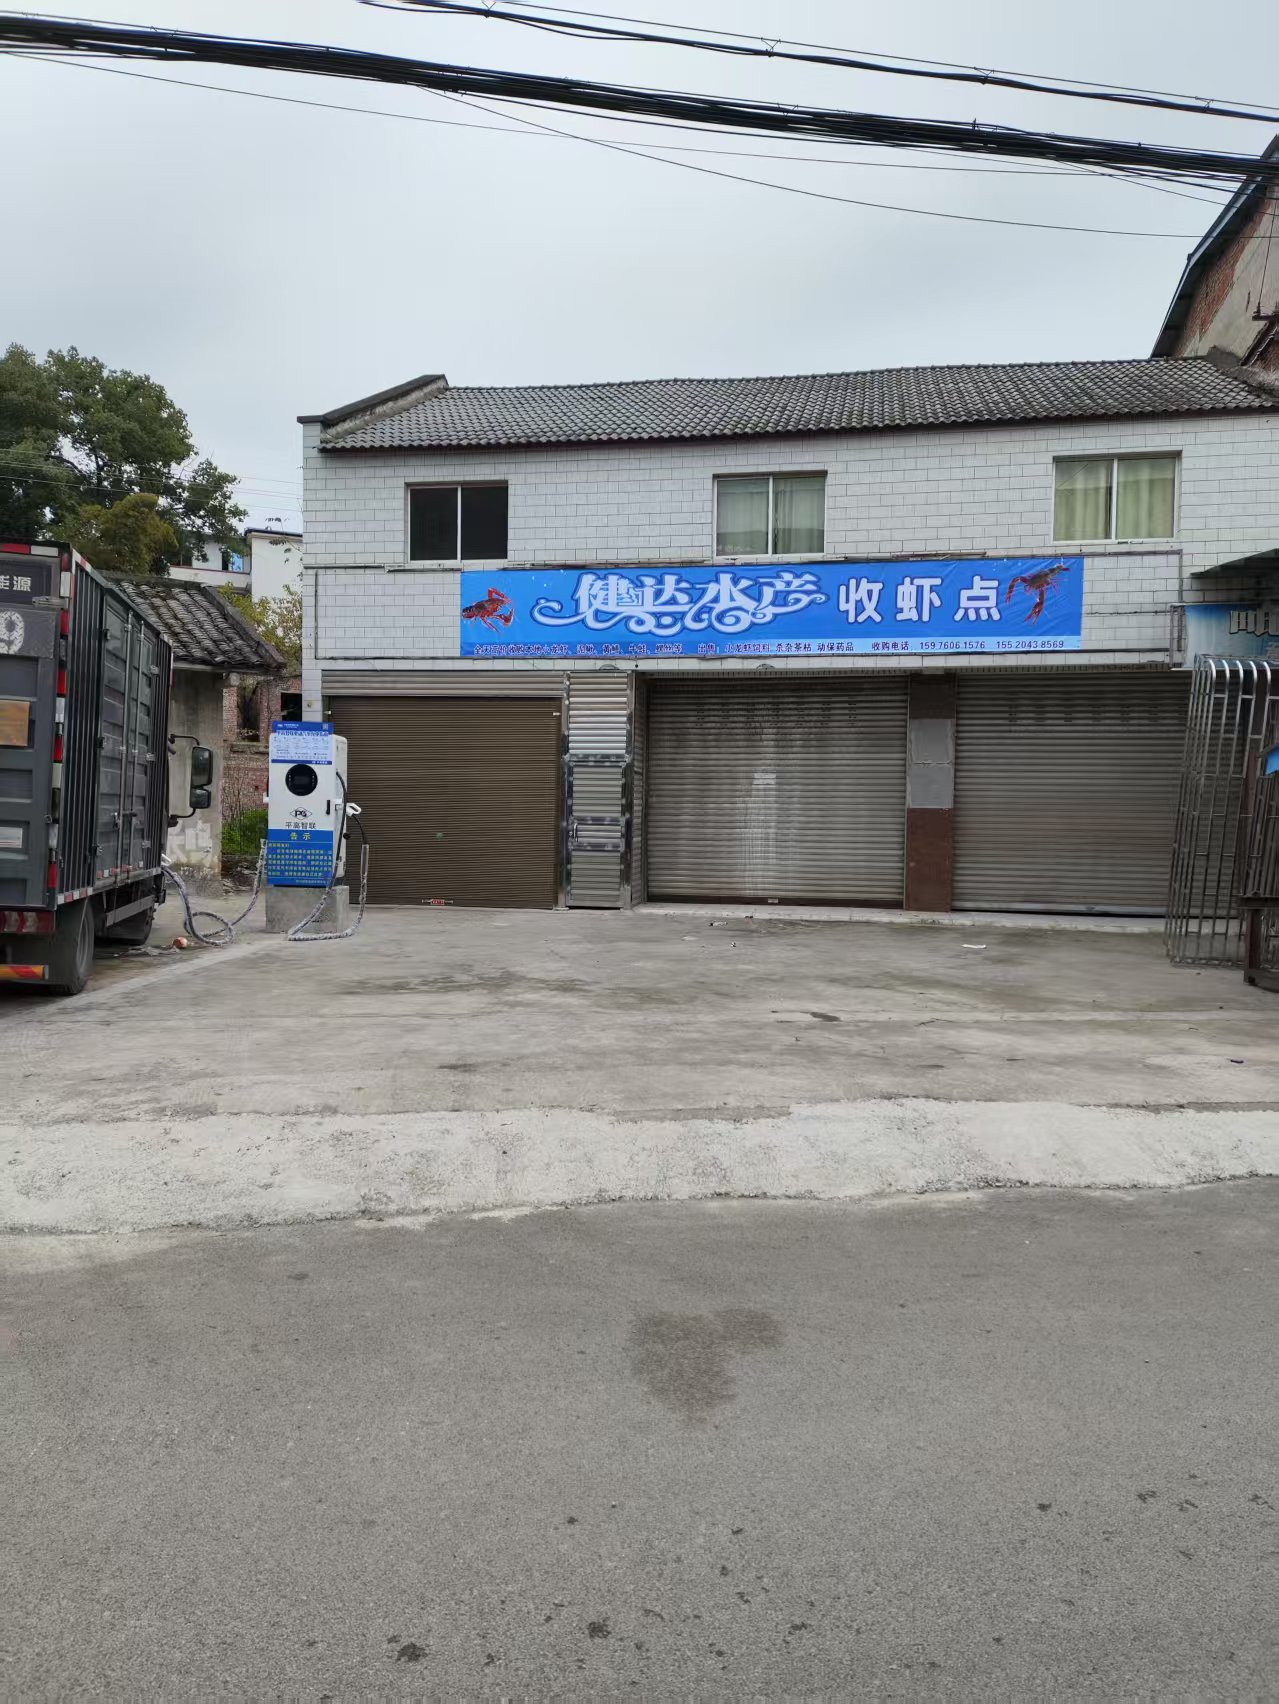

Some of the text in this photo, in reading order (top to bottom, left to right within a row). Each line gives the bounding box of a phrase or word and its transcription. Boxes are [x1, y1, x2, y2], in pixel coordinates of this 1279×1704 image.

[533, 572, 1001, 636] 健达水产 收虾点
[817, 641, 854, 652] 动保药品
[285, 821, 317, 830] 平高智联
